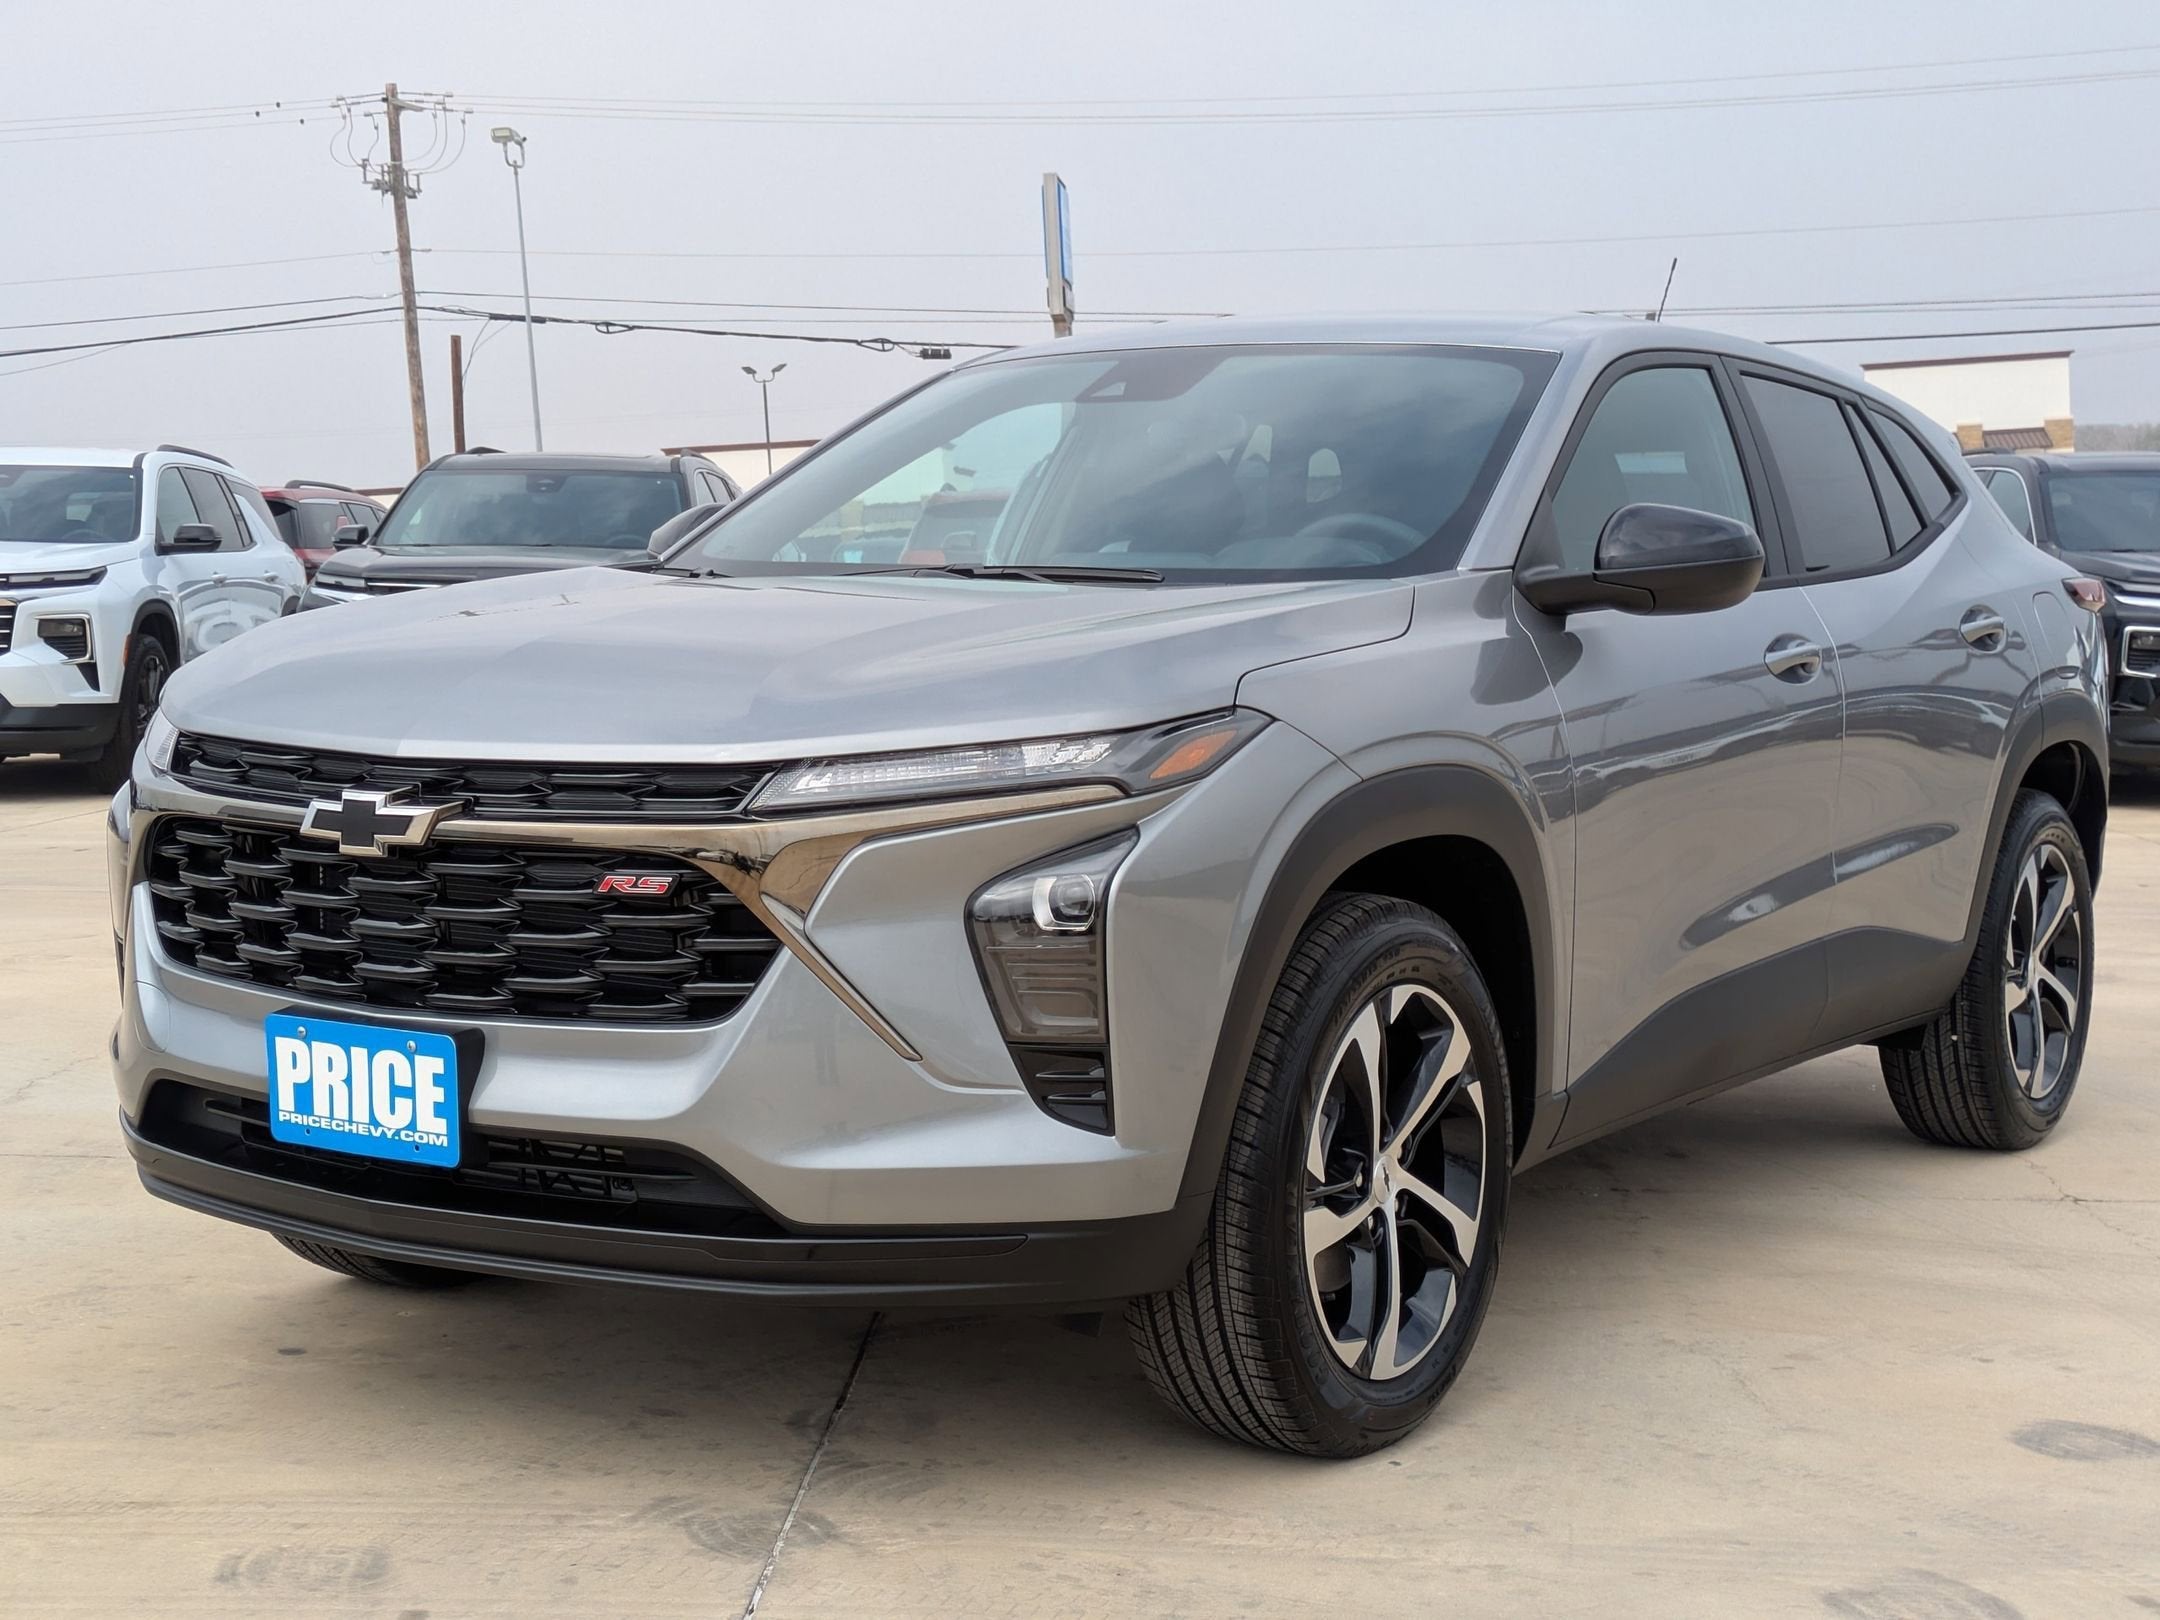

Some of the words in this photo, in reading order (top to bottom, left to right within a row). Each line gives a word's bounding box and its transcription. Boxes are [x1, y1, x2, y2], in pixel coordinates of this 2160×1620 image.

[597, 875, 673, 894] RS
[274, 1036, 448, 1135] PRICE
[278, 1110, 448, 1147] PRICECHEVY.COM
